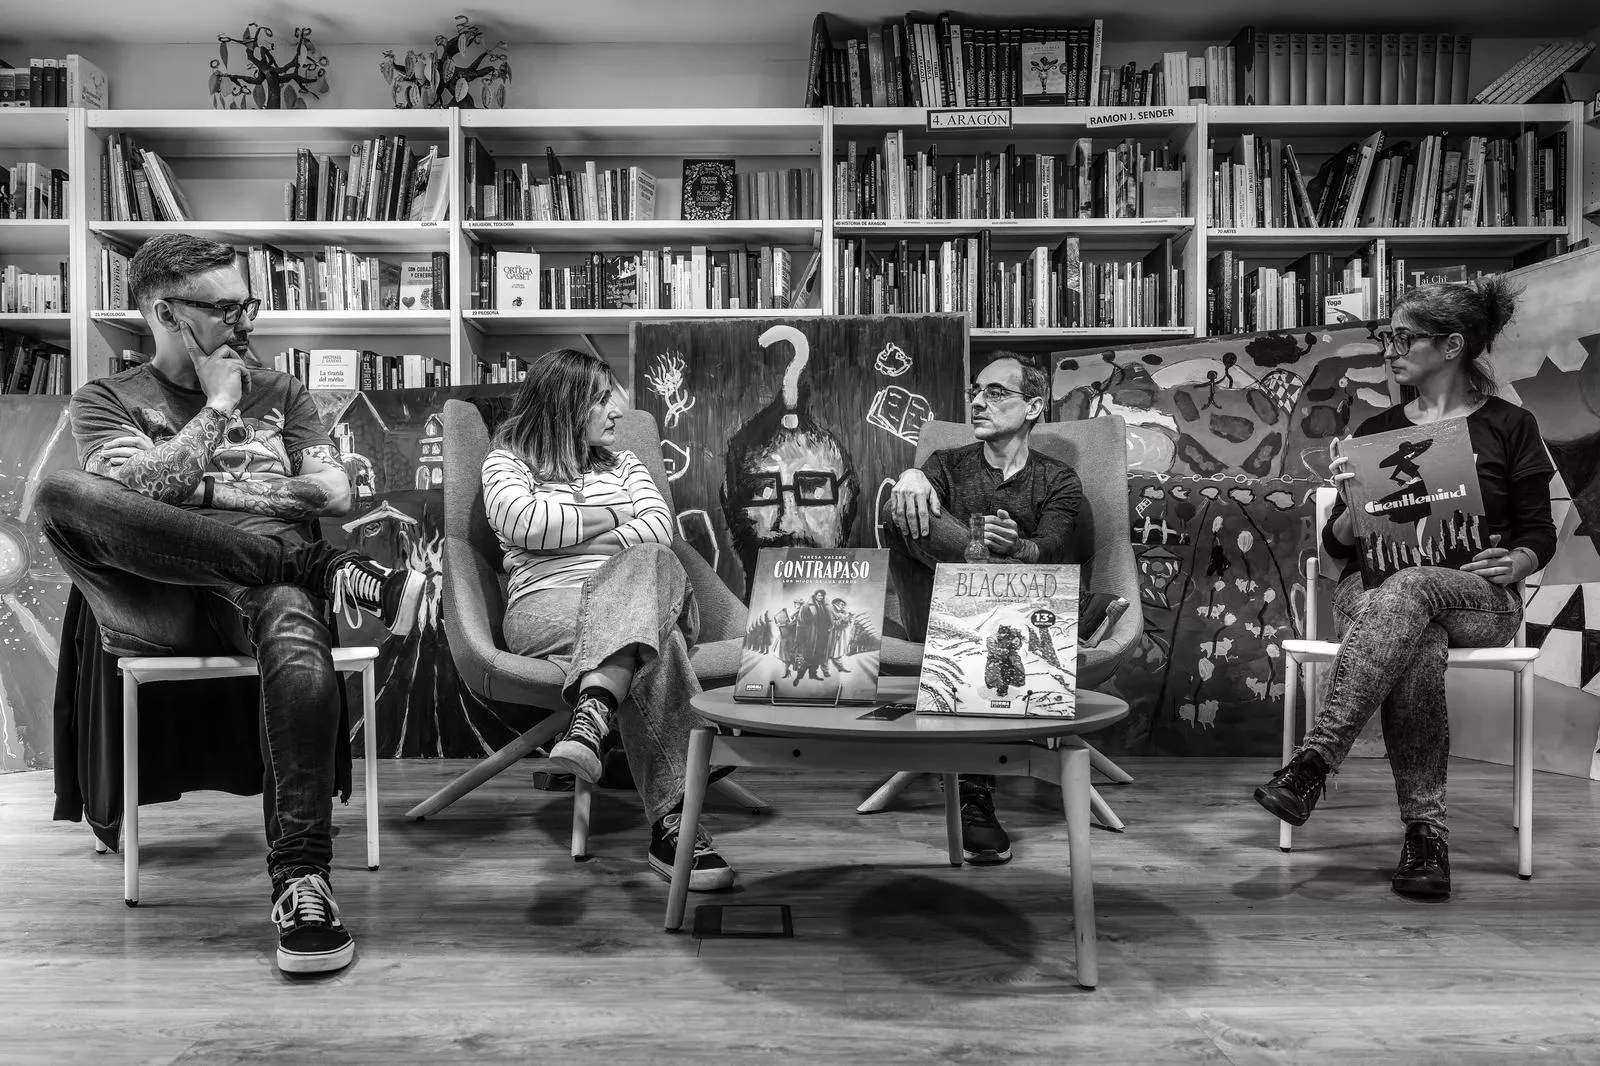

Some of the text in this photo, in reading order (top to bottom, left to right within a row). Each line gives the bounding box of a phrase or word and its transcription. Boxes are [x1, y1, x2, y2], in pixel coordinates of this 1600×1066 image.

[932, 112, 1007, 125] 4. ARAGÓN
[1090, 108, 1174, 125] RAMON J. SENDER
[503, 265, 533, 276] ORTEGA
[1431, 275, 1448, 284] Chi
[1364, 484, 1466, 514] Gentlemind
[774, 560, 870, 579] CONTRAPASO
[955, 572, 1057, 598] BLACKSAD
